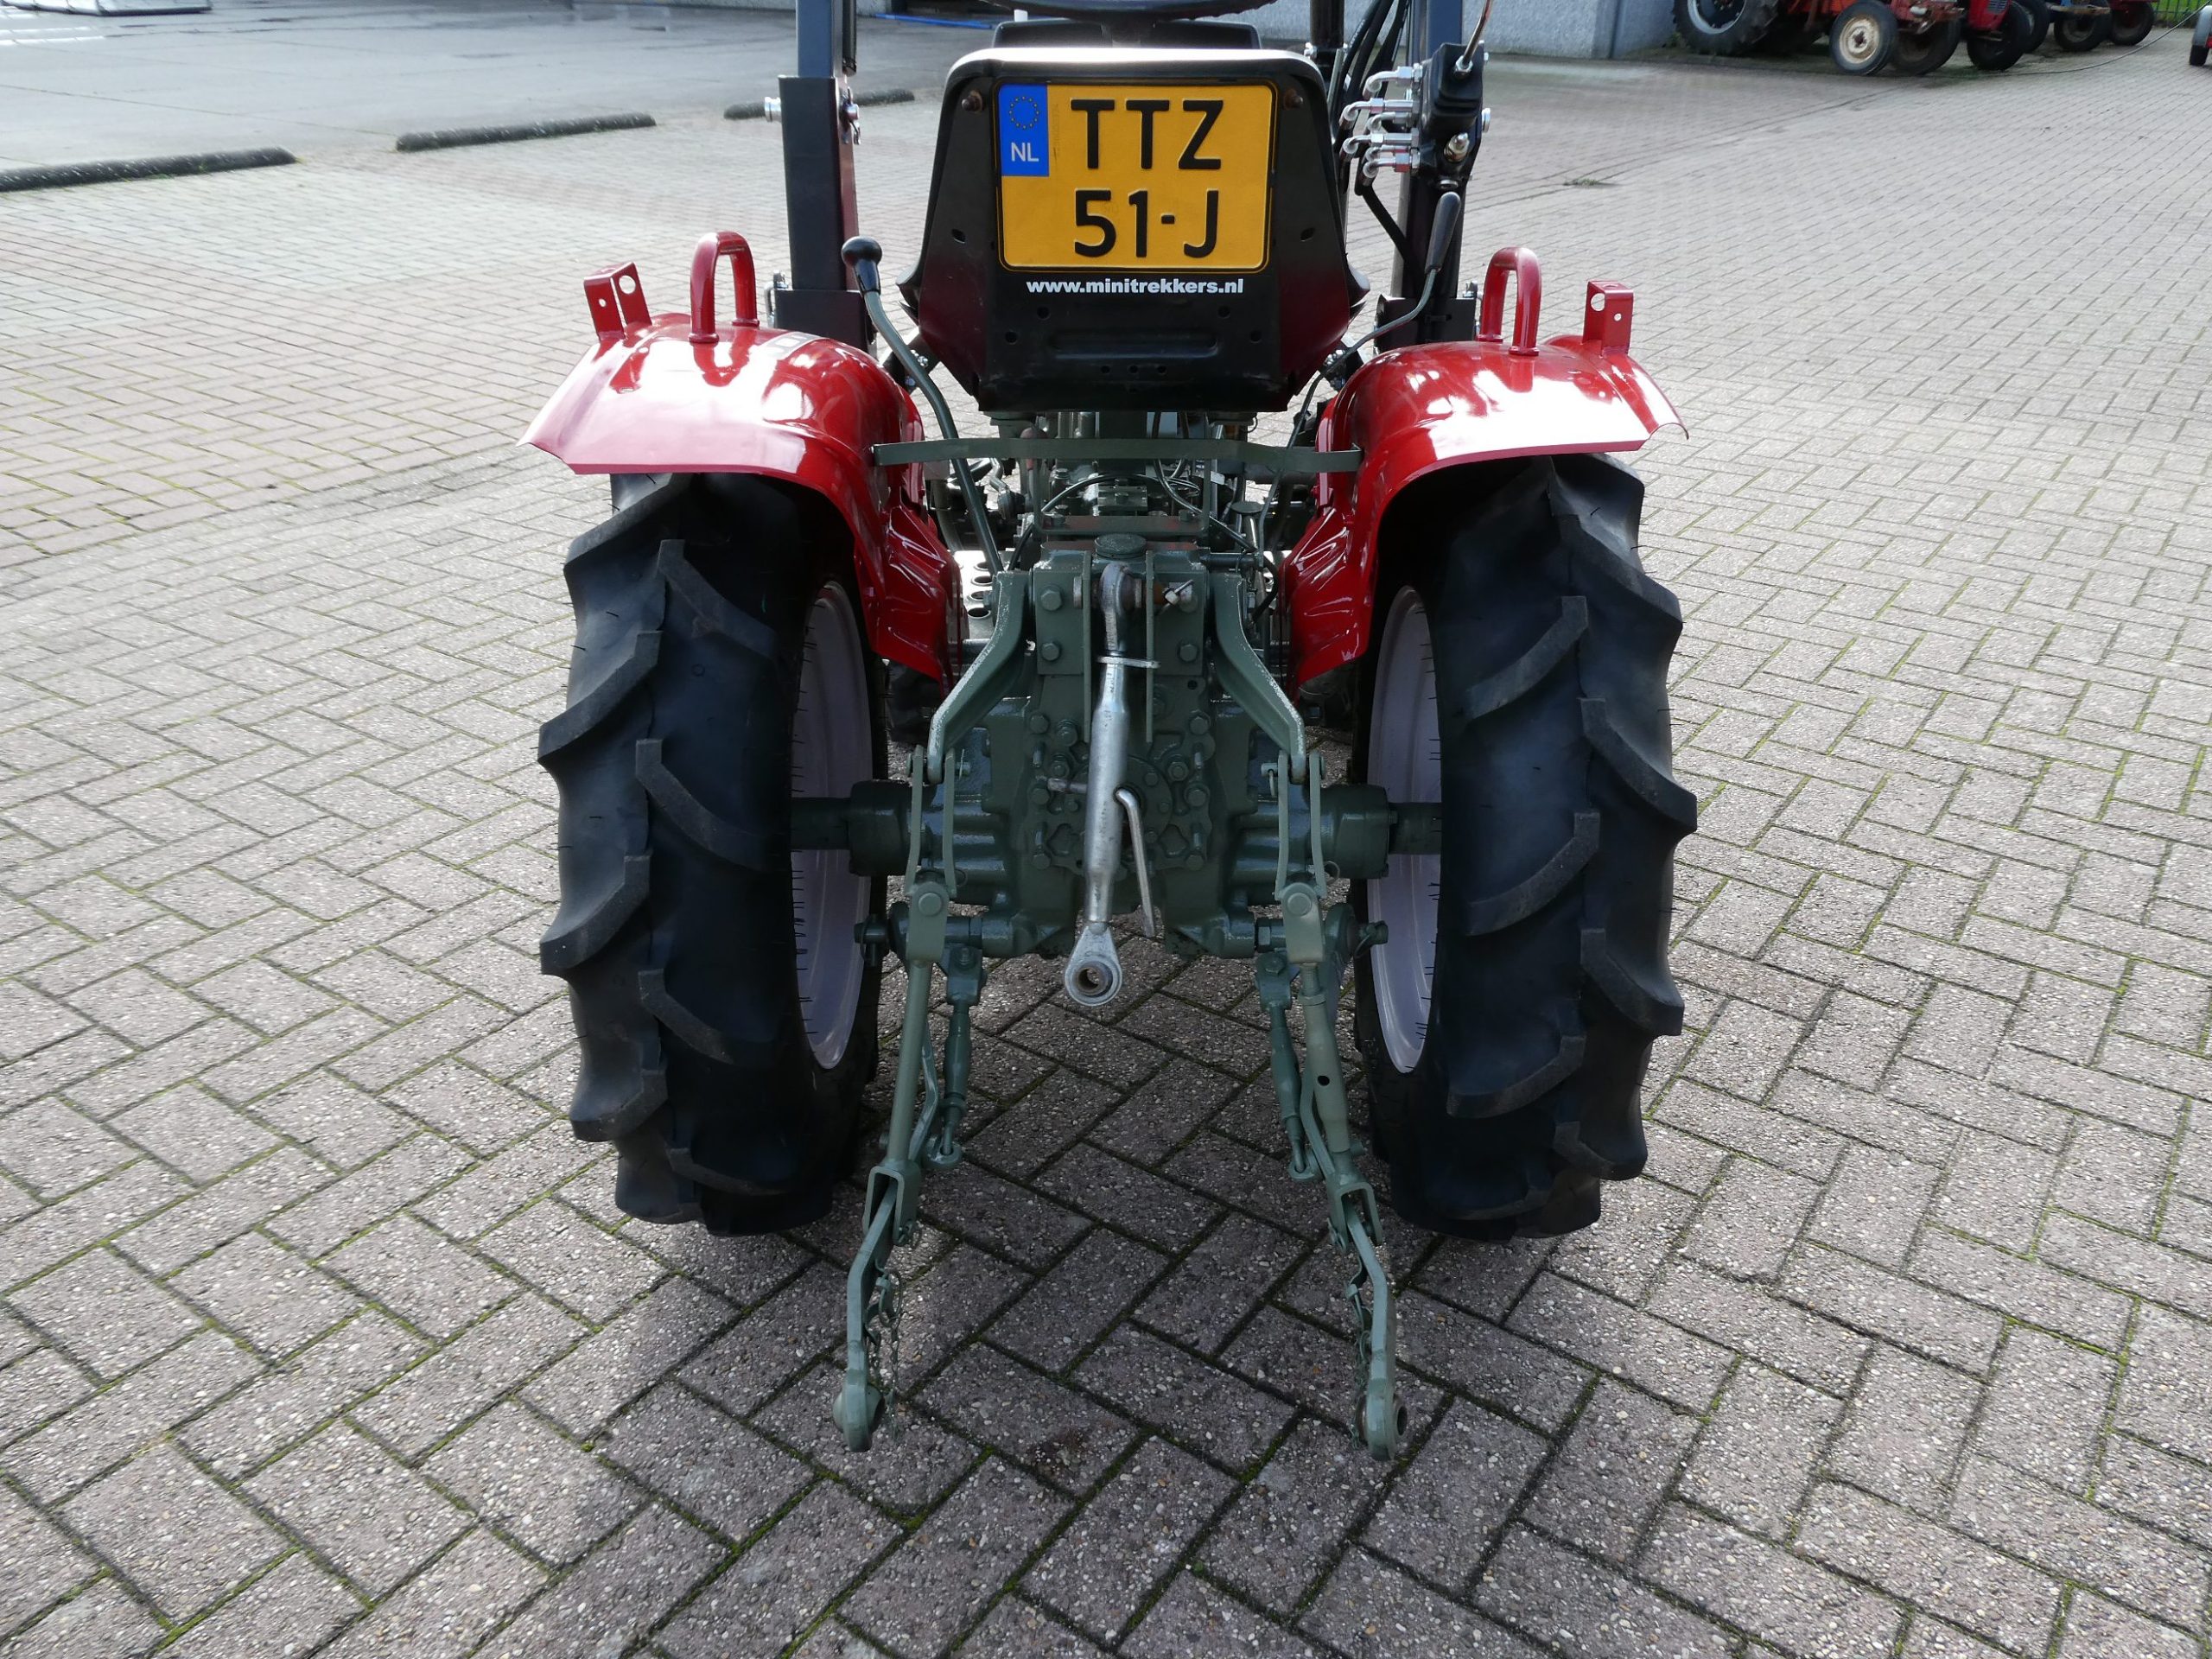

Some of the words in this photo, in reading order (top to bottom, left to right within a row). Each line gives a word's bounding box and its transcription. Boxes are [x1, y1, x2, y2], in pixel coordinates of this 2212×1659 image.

[1010, 142, 1039, 162] NL
[1071, 98, 1224, 170] TTZ
[1074, 188, 1219, 258] 51-J
[1026, 278, 1244, 294] www.minitrekkers.nl
